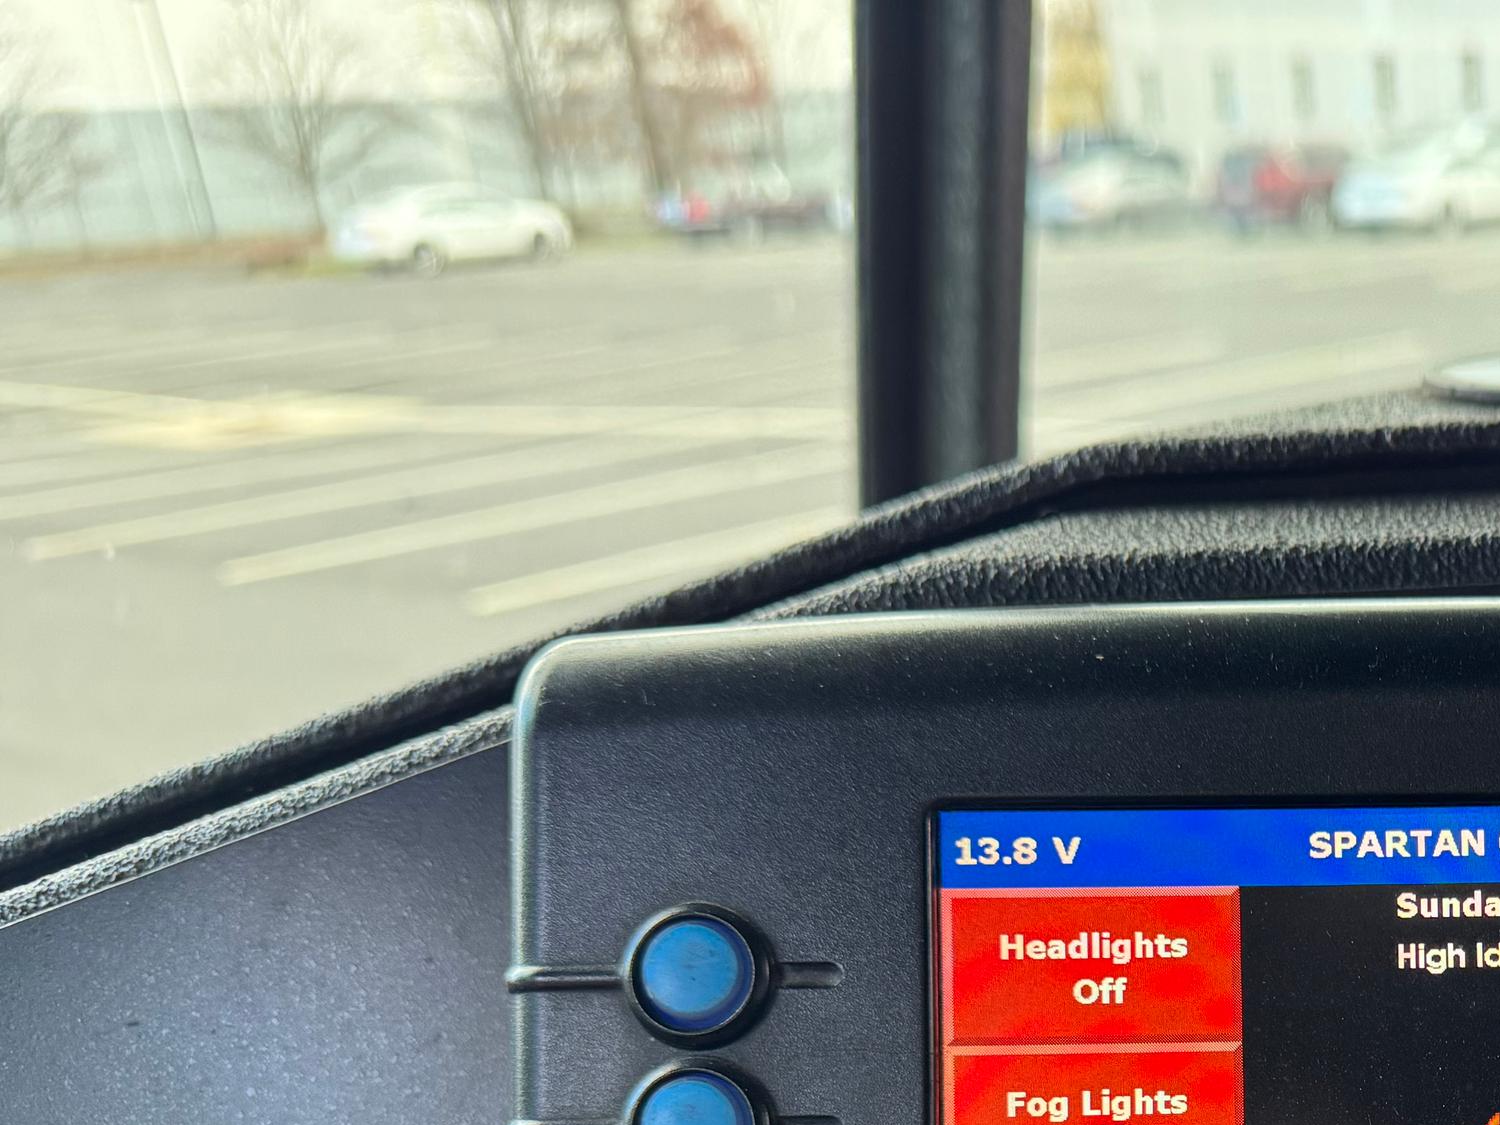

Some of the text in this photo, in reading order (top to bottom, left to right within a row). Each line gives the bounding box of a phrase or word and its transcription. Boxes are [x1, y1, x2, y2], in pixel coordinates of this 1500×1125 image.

[955, 836, 1082, 866] 13.8 V
[1309, 829, 1485, 859] SPARTAN
[999, 931, 1188, 965] Headlights
[1397, 942, 1466, 975] High
[1072, 976, 1128, 1005] Off
[1006, 1087, 1188, 1123] Fog Lights
